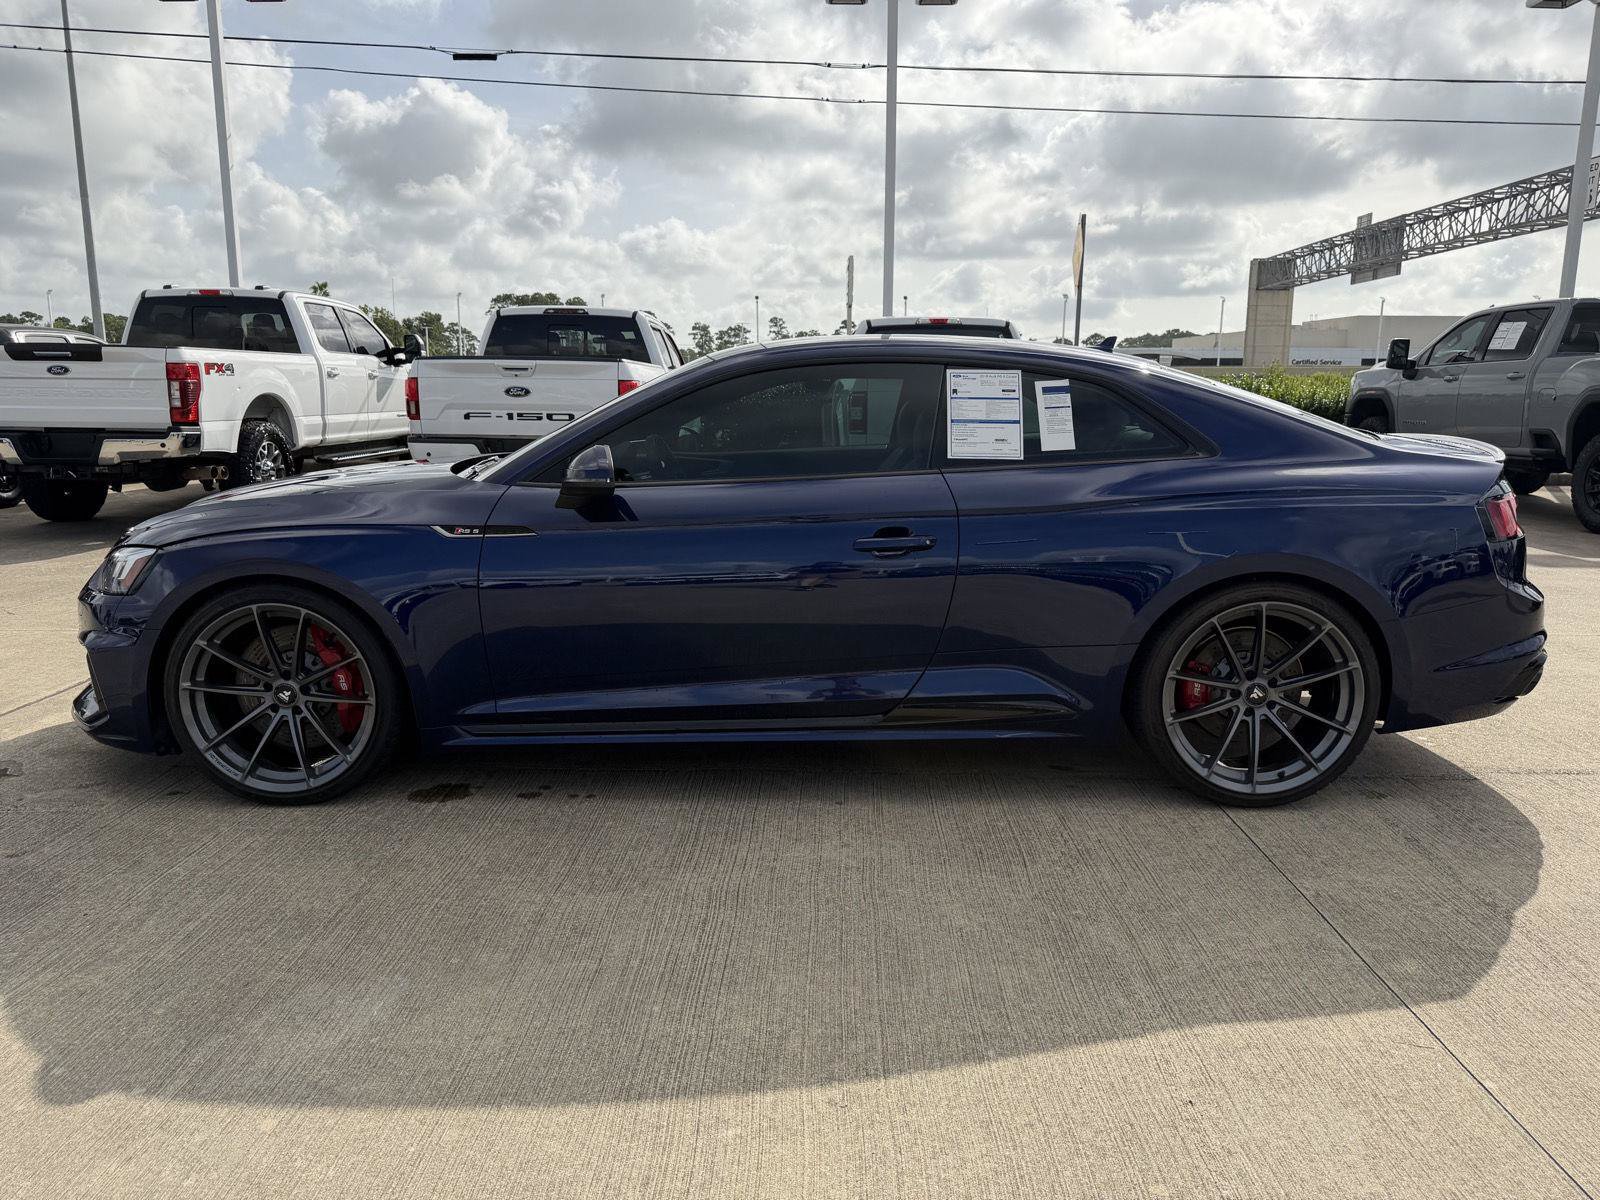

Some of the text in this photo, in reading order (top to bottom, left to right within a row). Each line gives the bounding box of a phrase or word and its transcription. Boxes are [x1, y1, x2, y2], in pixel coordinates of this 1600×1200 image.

[1291, 358, 1342, 366] Certified Service
[204, 362, 235, 375] FX4
[464, 412, 575, 421] F-150
[338, 674, 348, 691] RS
